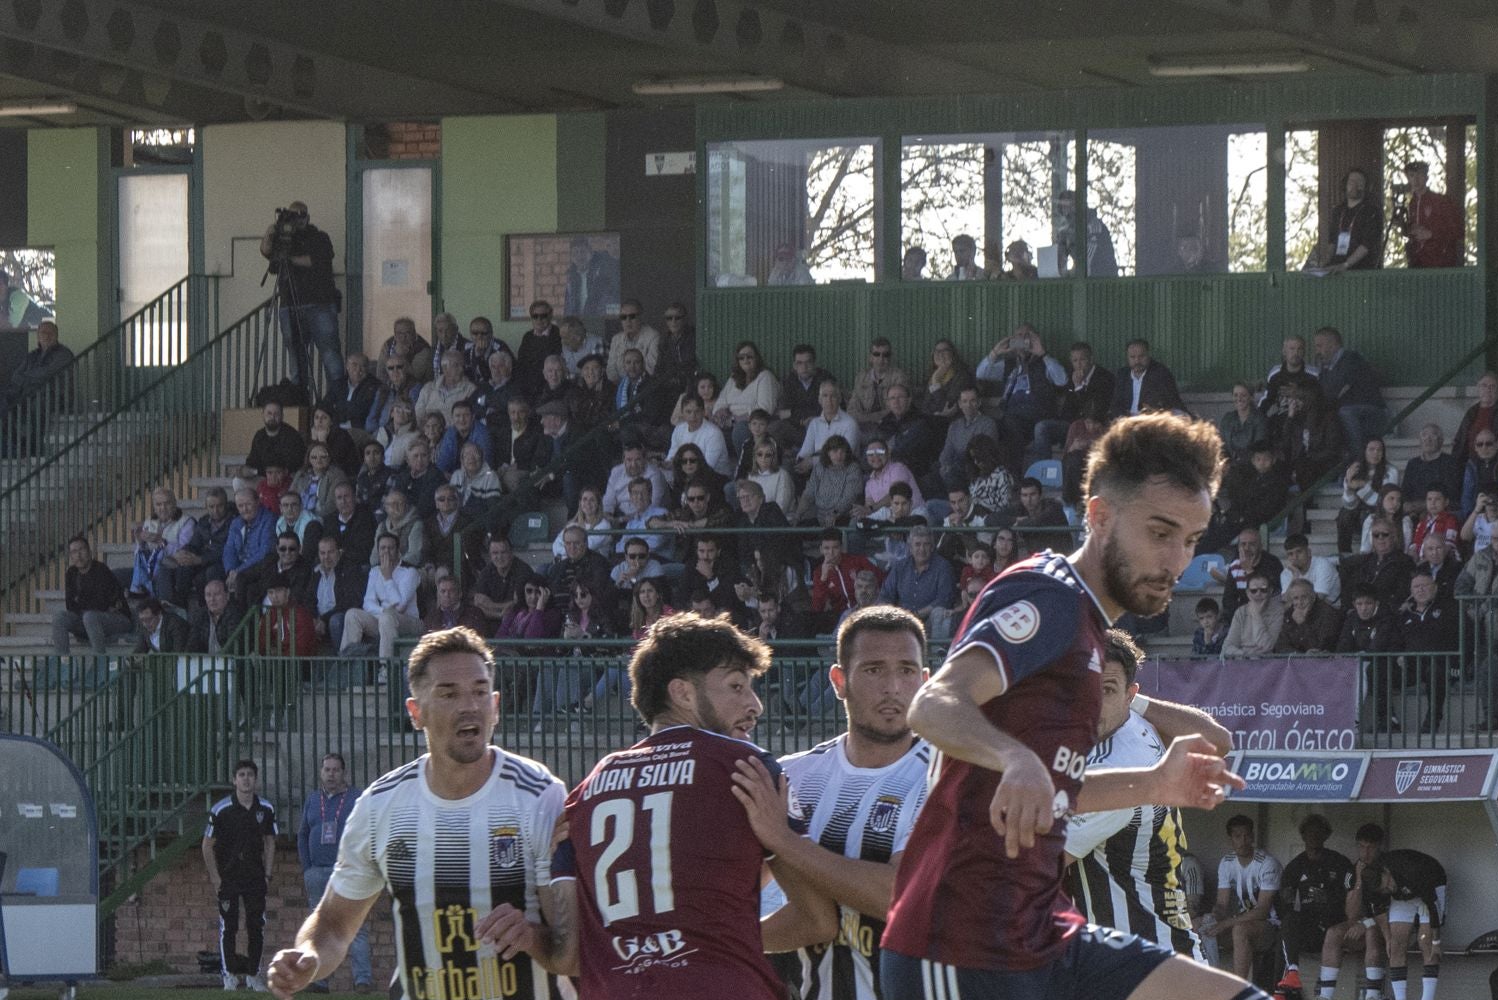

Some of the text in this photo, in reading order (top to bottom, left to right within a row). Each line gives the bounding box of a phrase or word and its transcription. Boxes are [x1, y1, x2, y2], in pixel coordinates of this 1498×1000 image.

[1260, 703, 1325, 718] Segoviana
[1233, 720, 1355, 750] ICOLÓGICO
[583, 759, 696, 801] JUAN SILVA
[1245, 763, 1349, 781] BIOAMMO
[1419, 775, 1458, 784] SEGOVIANA
[1423, 763, 1466, 774] GIMNÁSTICA
[1296, 783, 1343, 791] Ammunition
[590, 791, 674, 928] 21
[612, 929, 686, 960] G&B
[412, 957, 518, 1000] carballo
